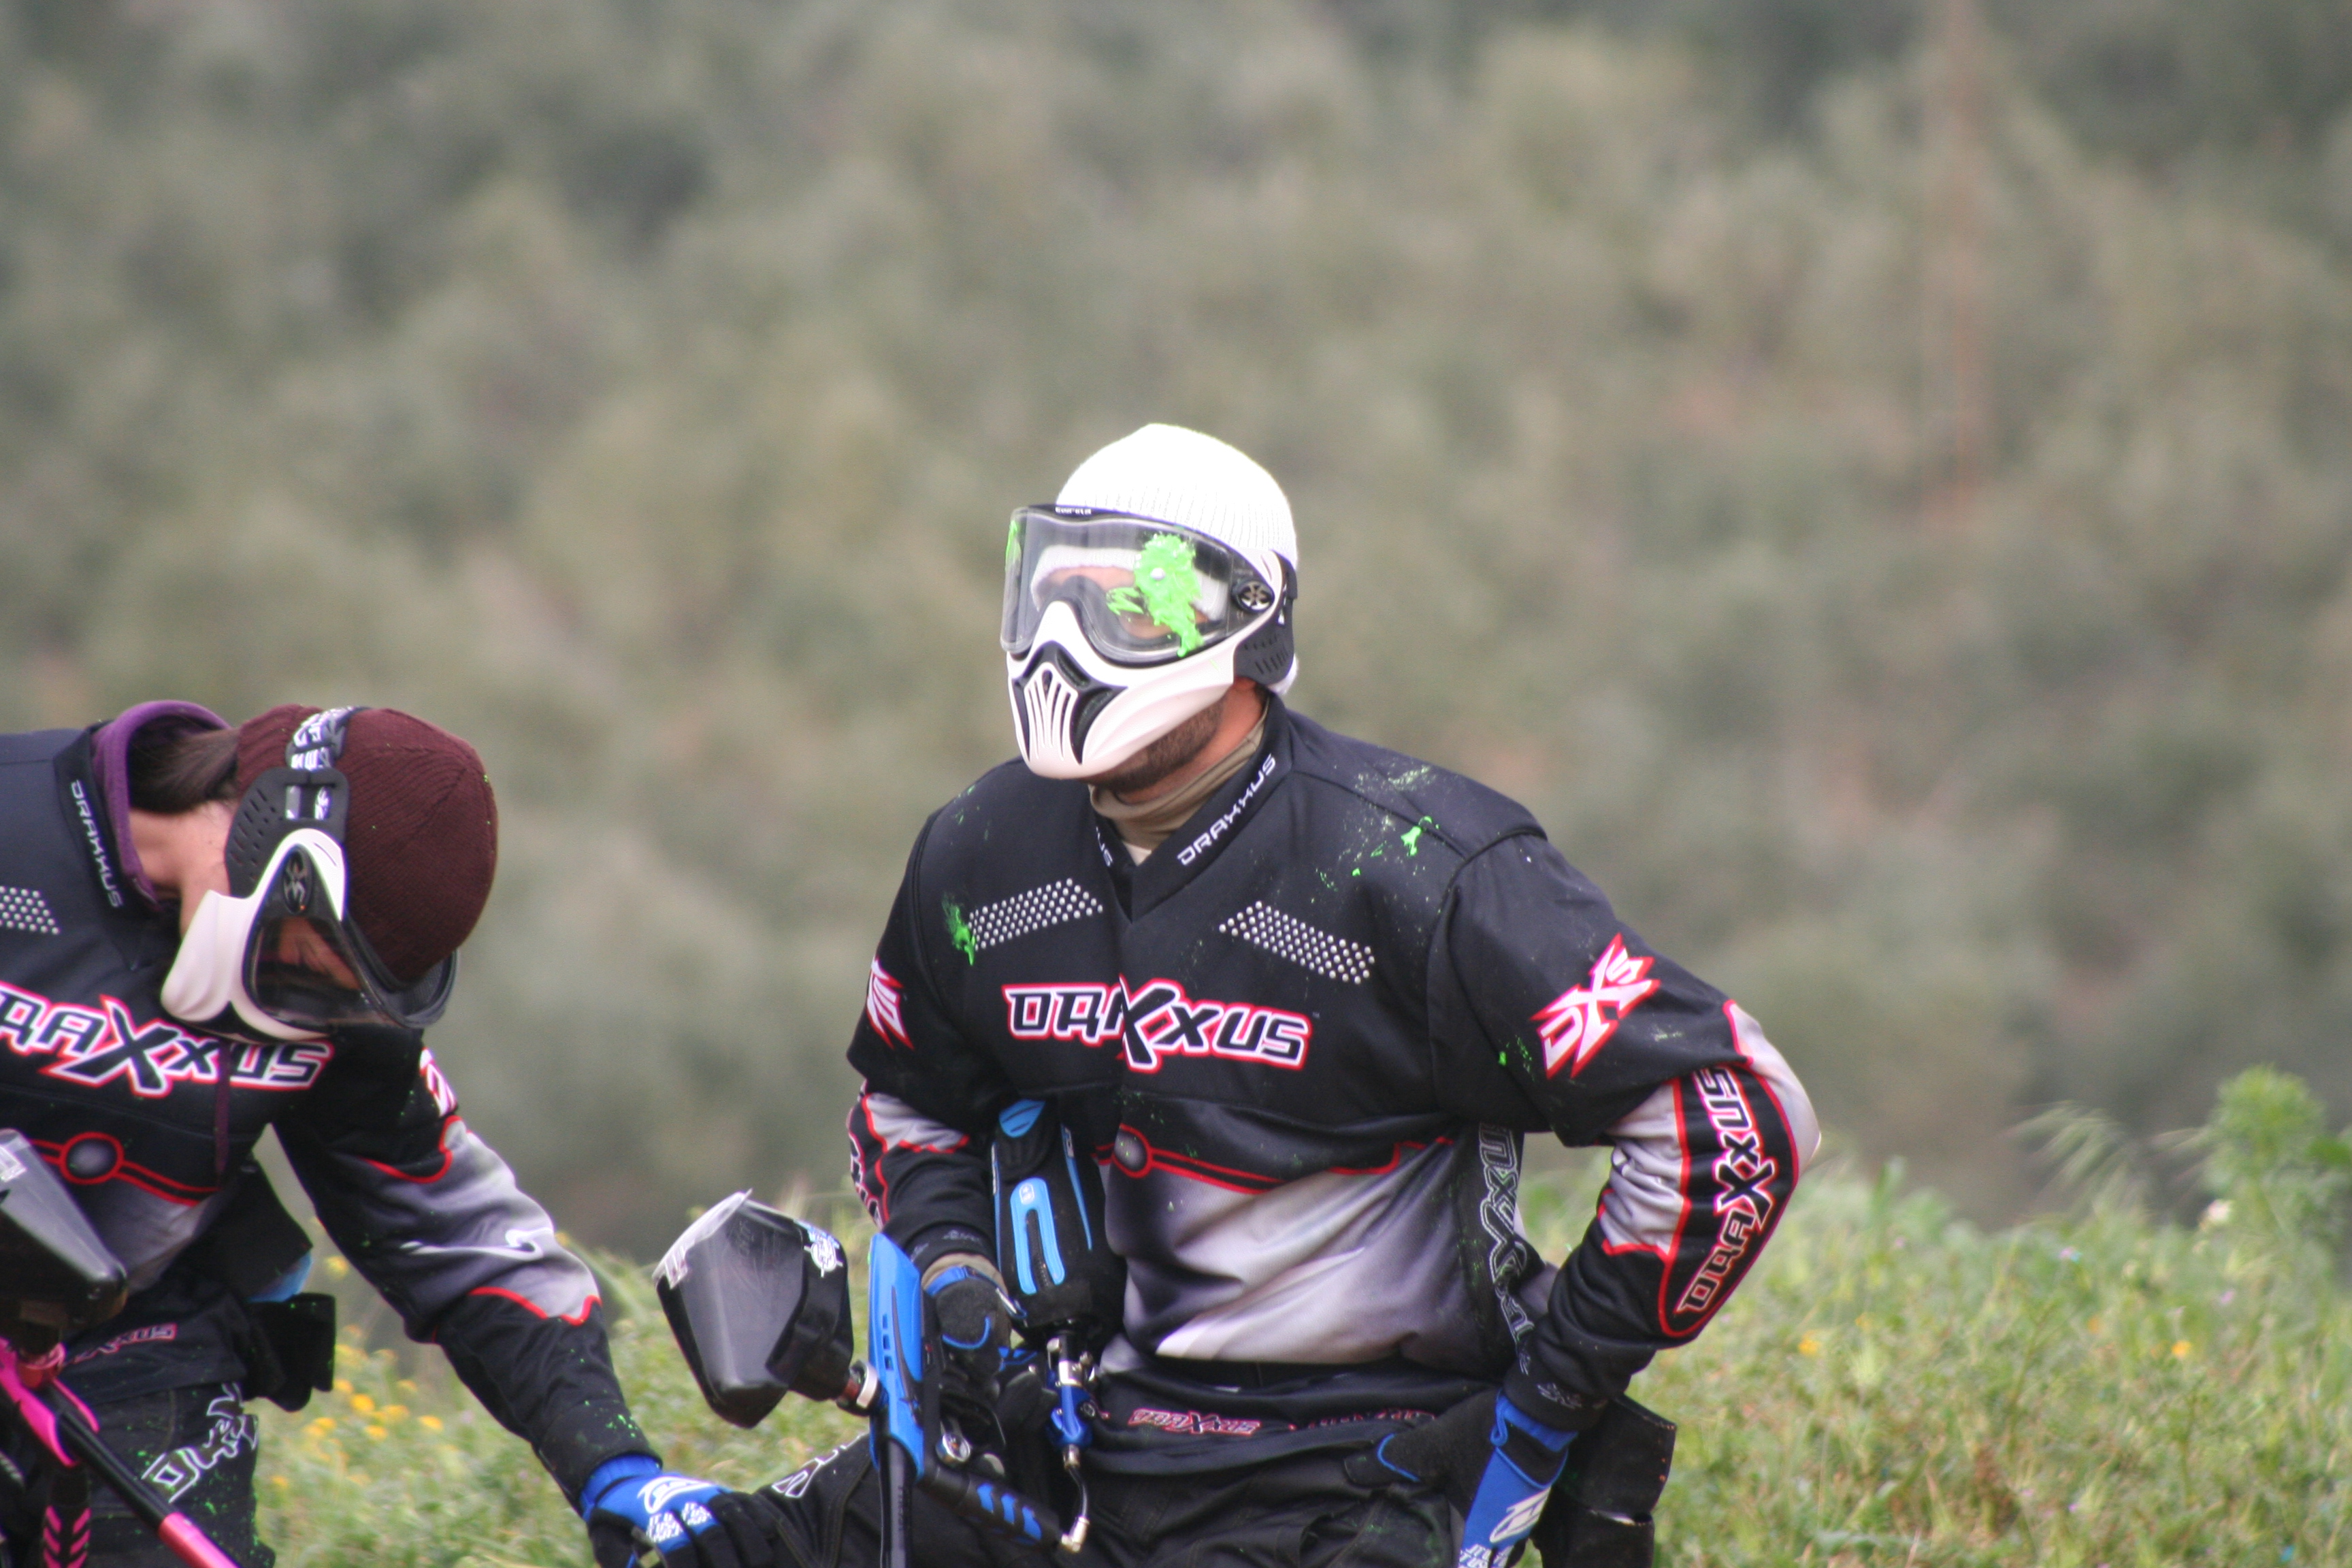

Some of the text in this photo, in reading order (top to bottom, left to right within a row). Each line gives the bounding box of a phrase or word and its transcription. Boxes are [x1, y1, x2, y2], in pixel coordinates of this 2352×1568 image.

[1177, 752, 1277, 866] DRAXXUS
[0, 981, 335, 1098] RAXXUS
[1674, 1065, 1782, 1316] DRAXXUS
